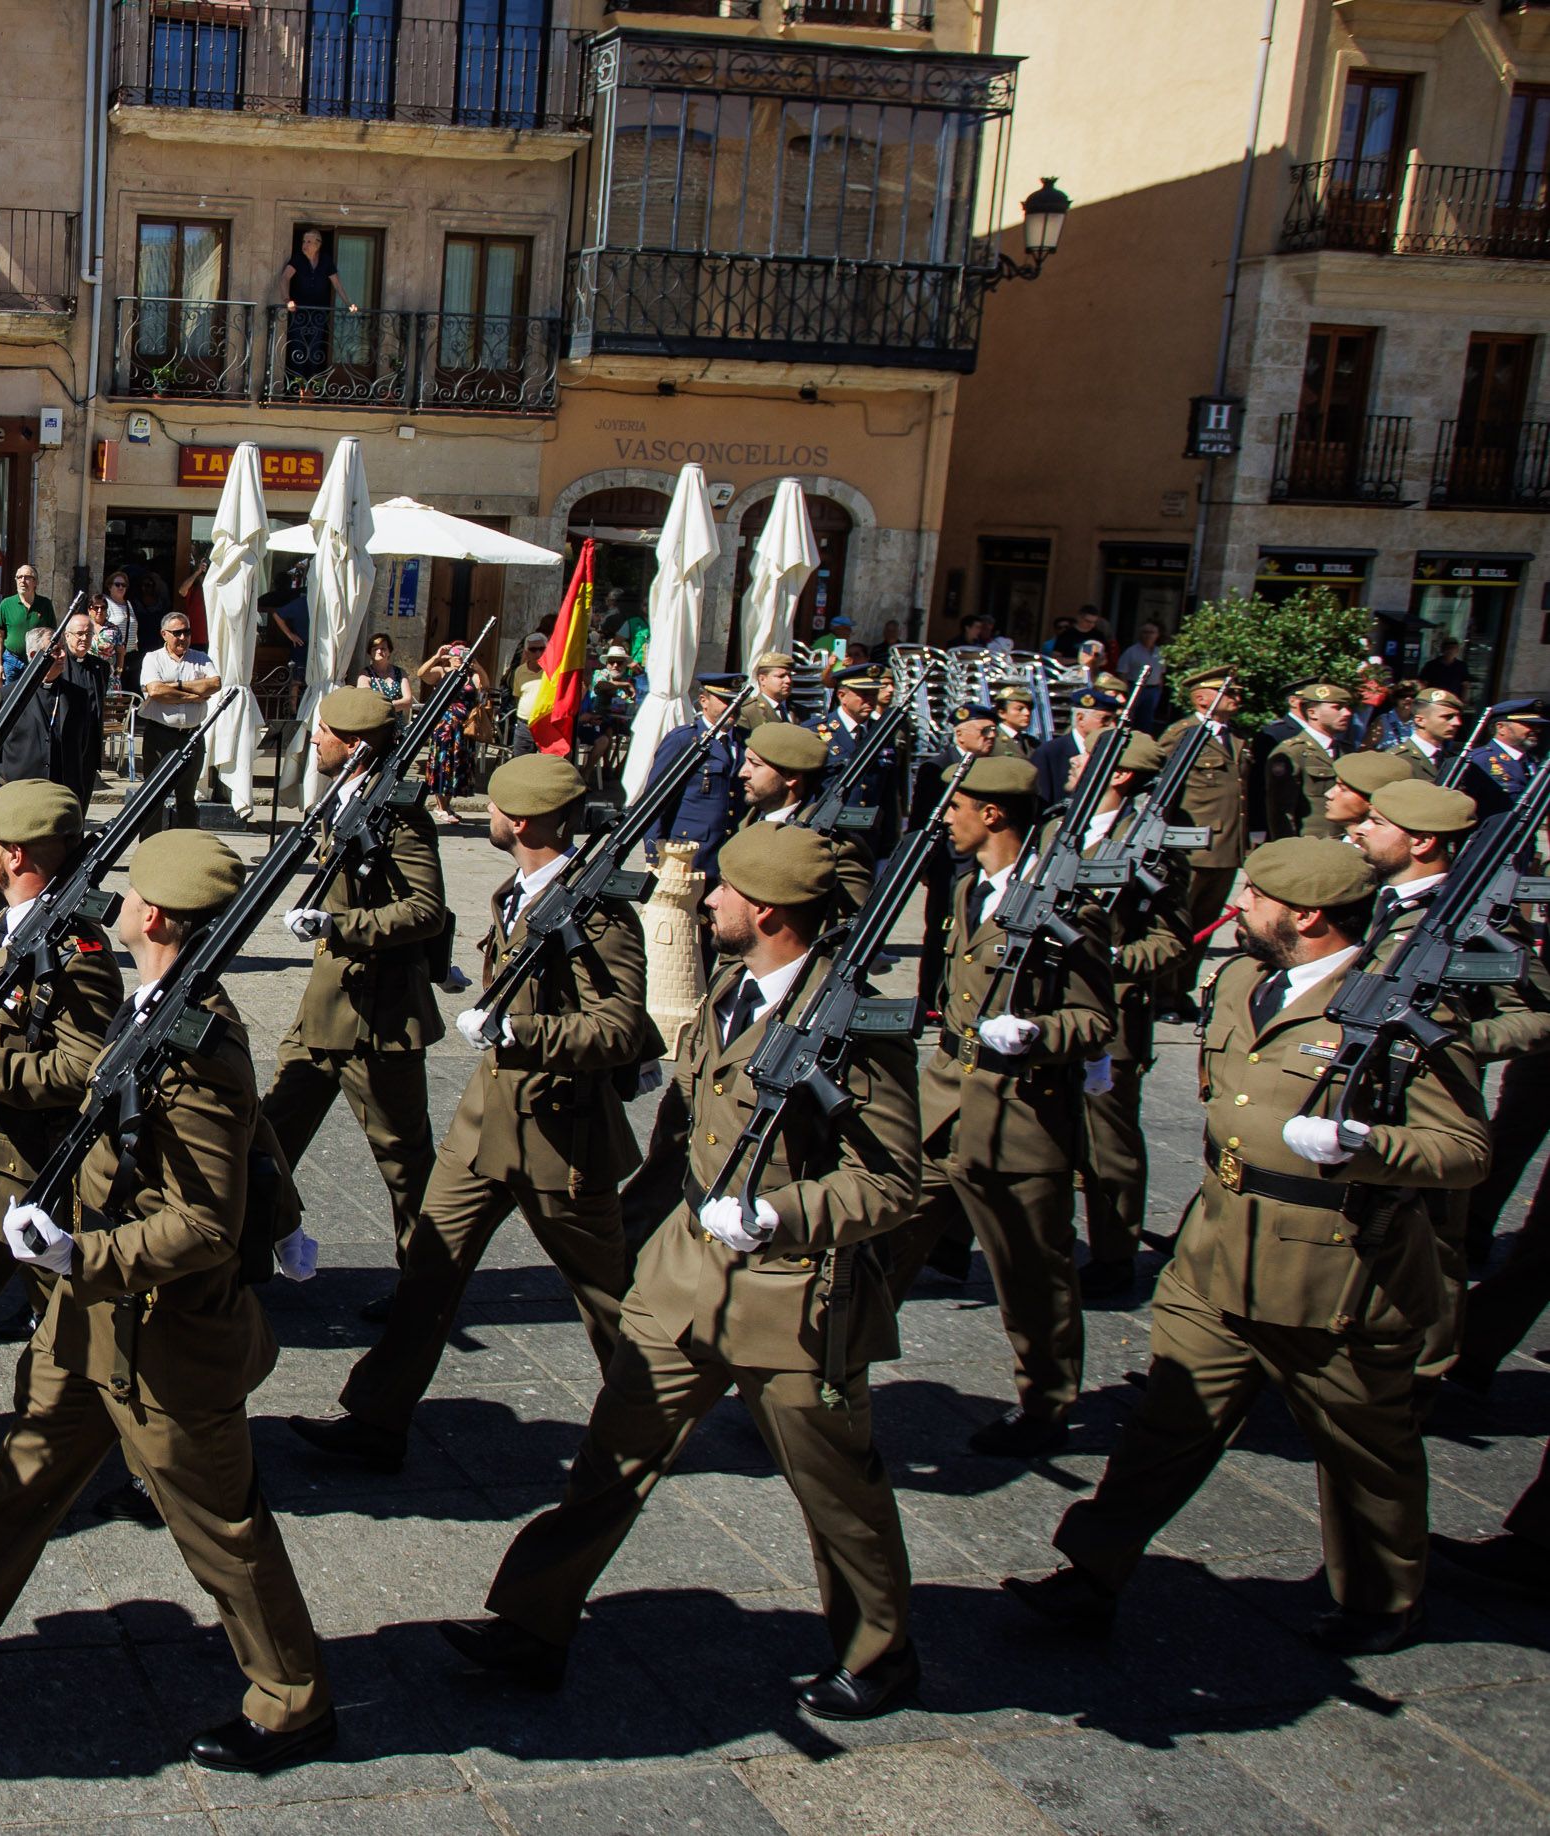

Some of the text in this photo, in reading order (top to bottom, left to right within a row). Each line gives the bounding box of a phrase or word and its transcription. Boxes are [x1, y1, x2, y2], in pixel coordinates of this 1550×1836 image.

[594, 418, 647, 432] JOYERIA
[1205, 404, 1233, 430] H
[614, 437, 829, 468] VASCONCELLOS
[192, 453, 315, 475] TACOS
[474, 499, 482, 510] 8
